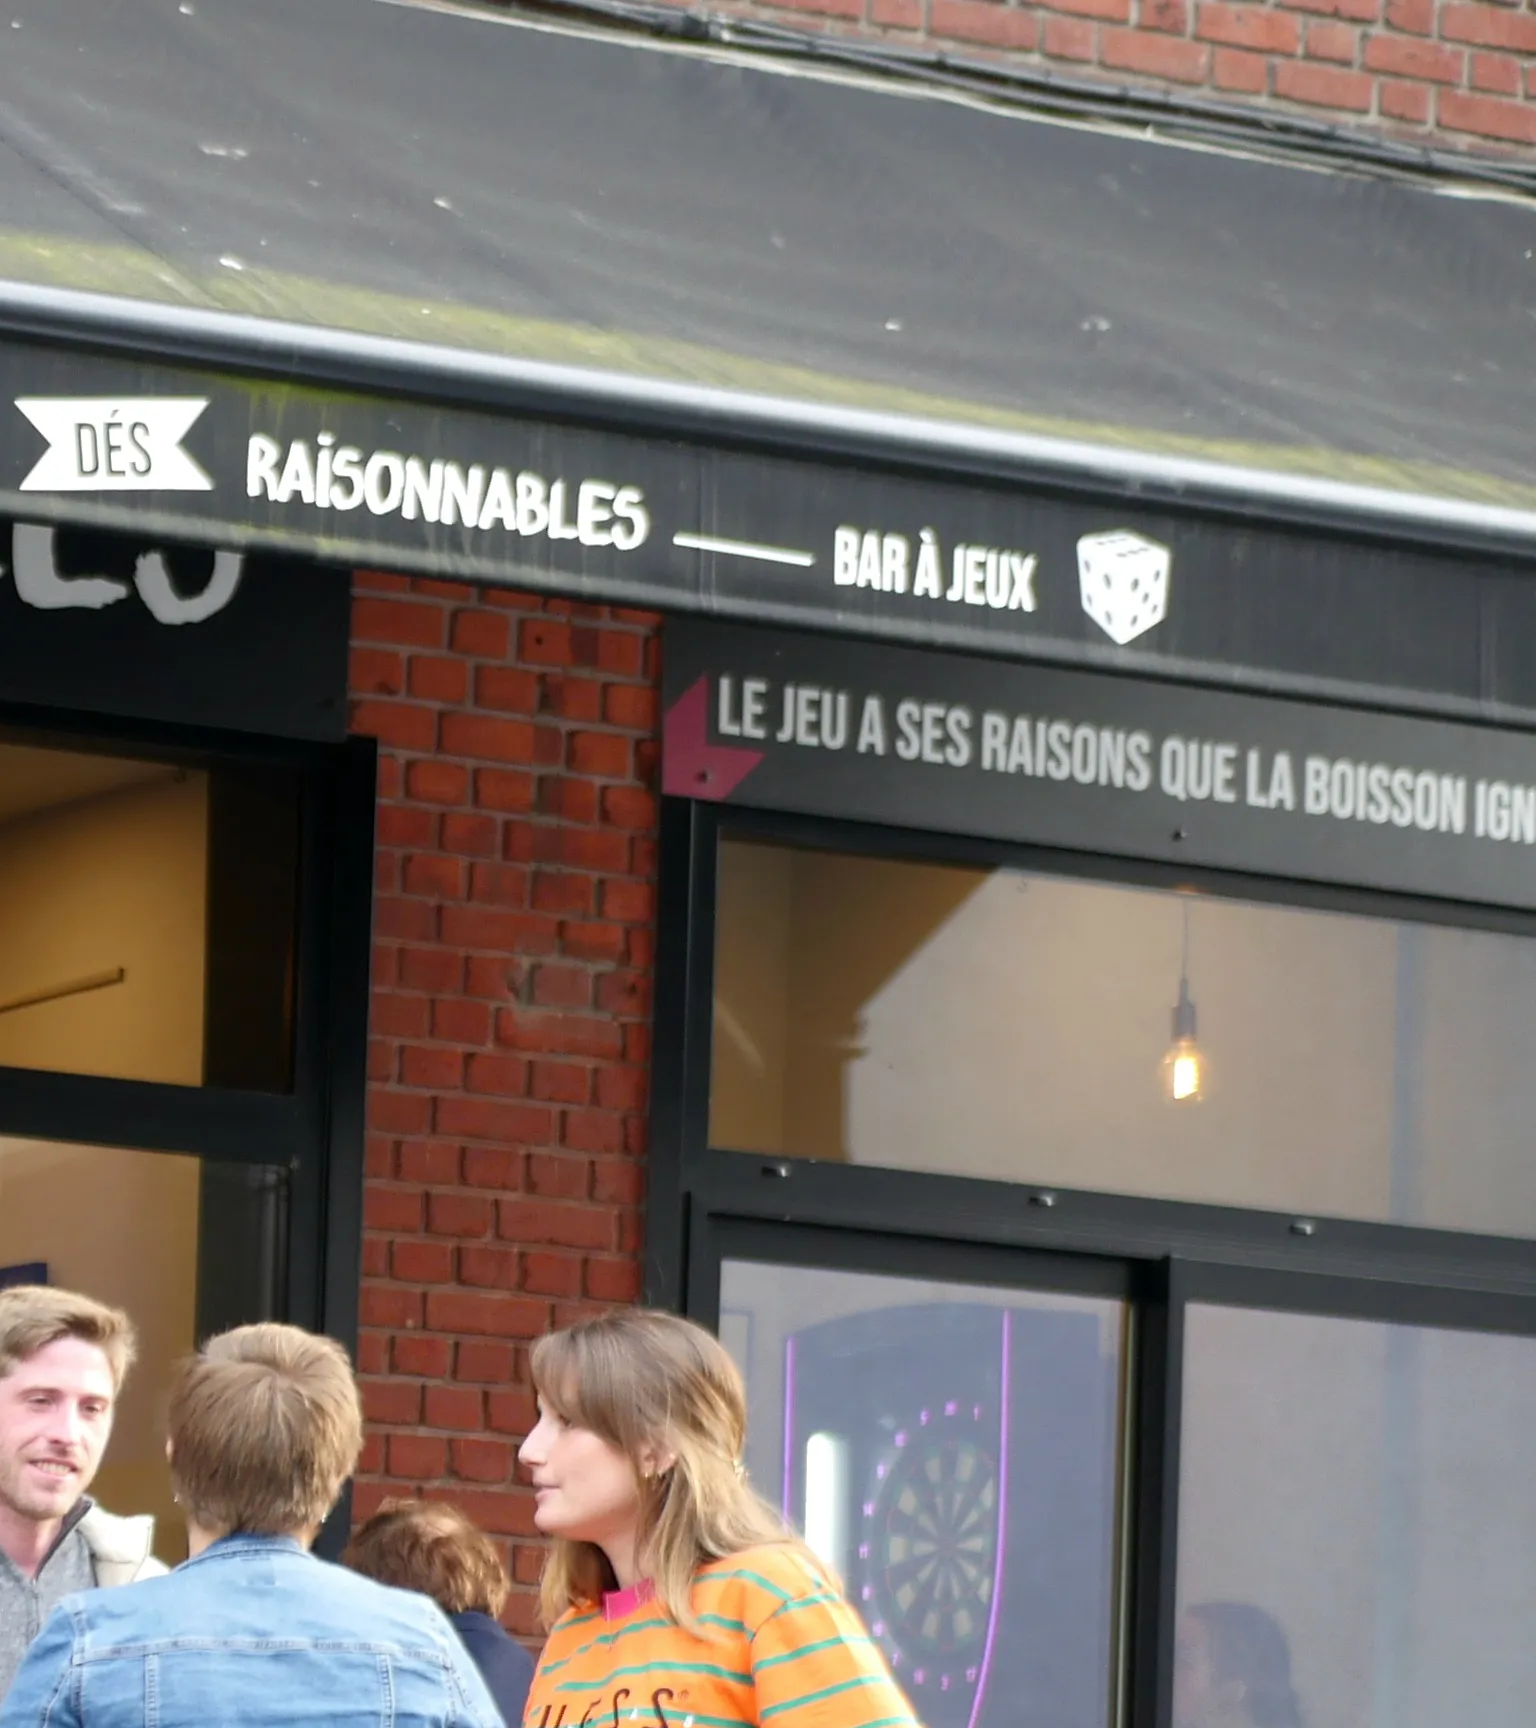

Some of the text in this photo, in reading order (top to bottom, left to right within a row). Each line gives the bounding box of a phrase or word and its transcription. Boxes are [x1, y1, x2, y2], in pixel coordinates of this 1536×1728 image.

[74, 409, 153, 477] DÉS
[833, 526, 1038, 612] BAR À JEUX
[718, 675, 767, 739] LE
[776, 686, 849, 751] JEU
[857, 695, 887, 756] A
[895, 698, 972, 768] SES
[981, 713, 1150, 792] RAISONS
[1160, 735, 1238, 802] QUE
[1246, 748, 1295, 812] LA
[1304, 755, 1468, 835] BOISSON
